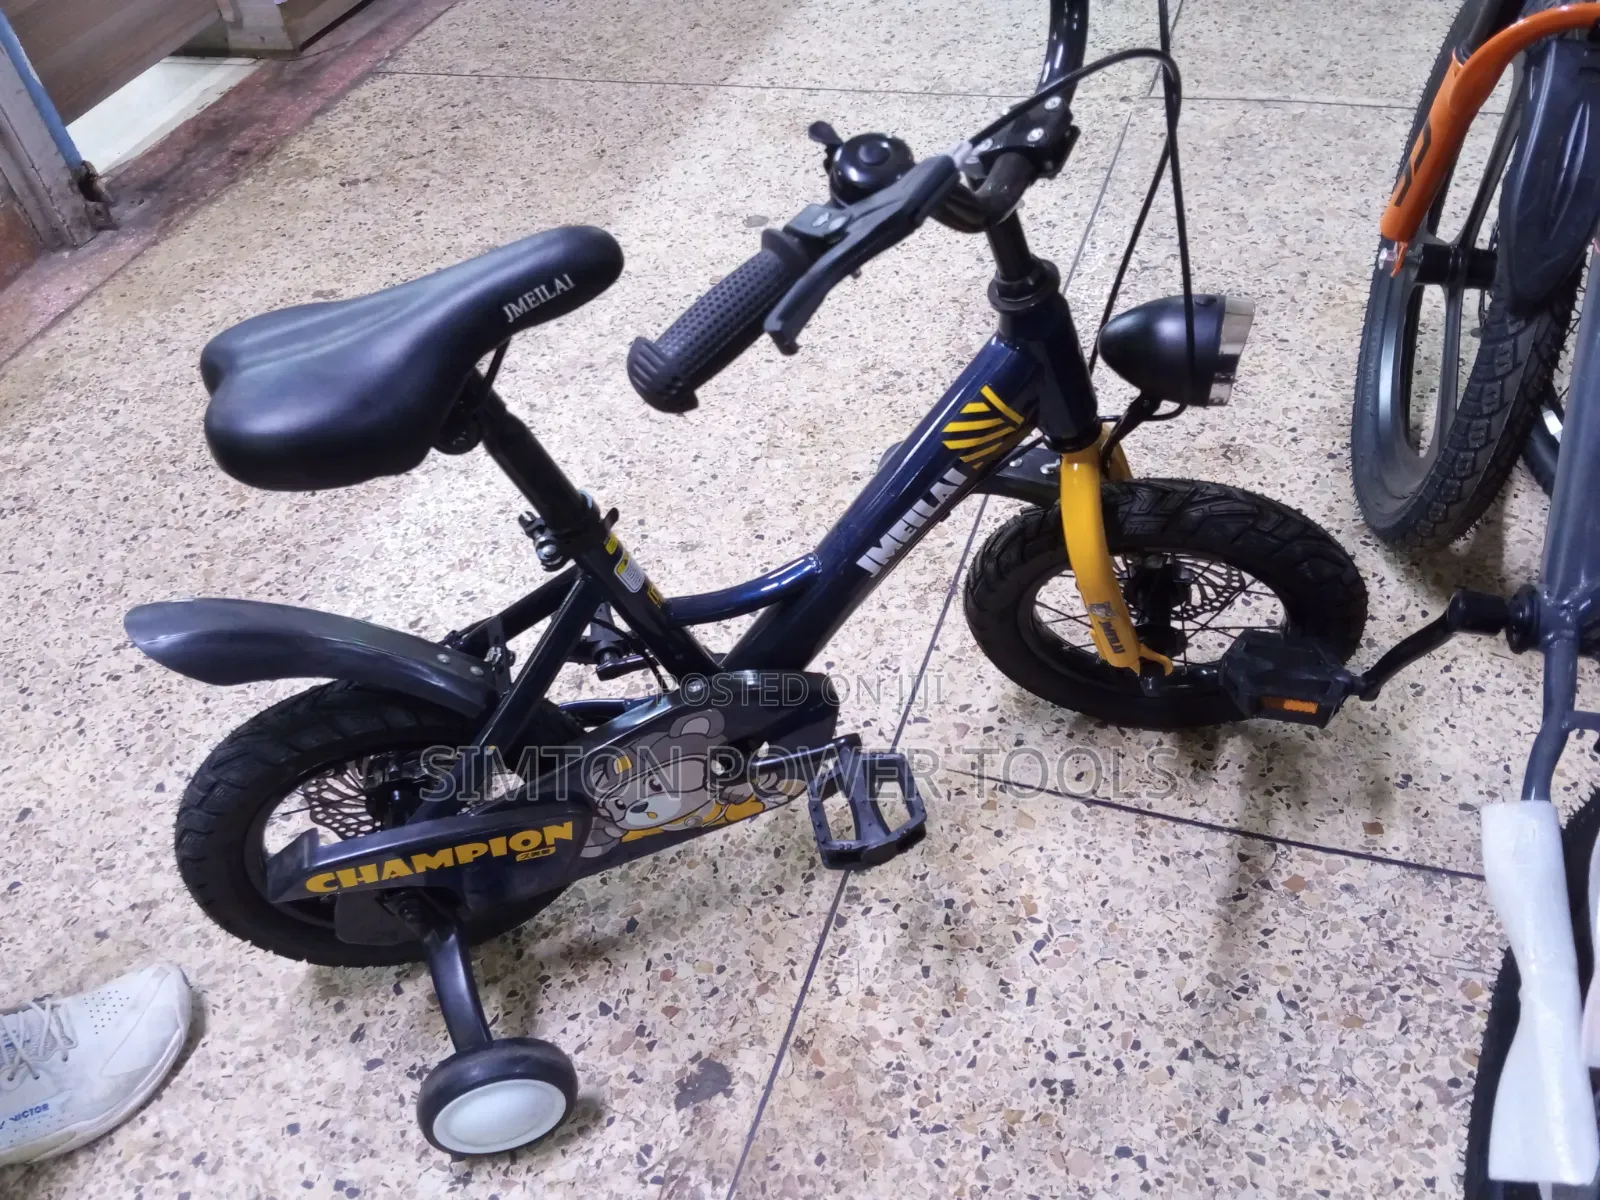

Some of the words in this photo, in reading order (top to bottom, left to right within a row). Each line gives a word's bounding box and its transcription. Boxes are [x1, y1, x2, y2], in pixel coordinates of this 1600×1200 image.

[502, 273, 576, 323] JMEILAI
[856, 467, 968, 578] JMEILAI
[305, 821, 573, 893] CHAMPION
[9, 1103, 49, 1122] VICTOR
